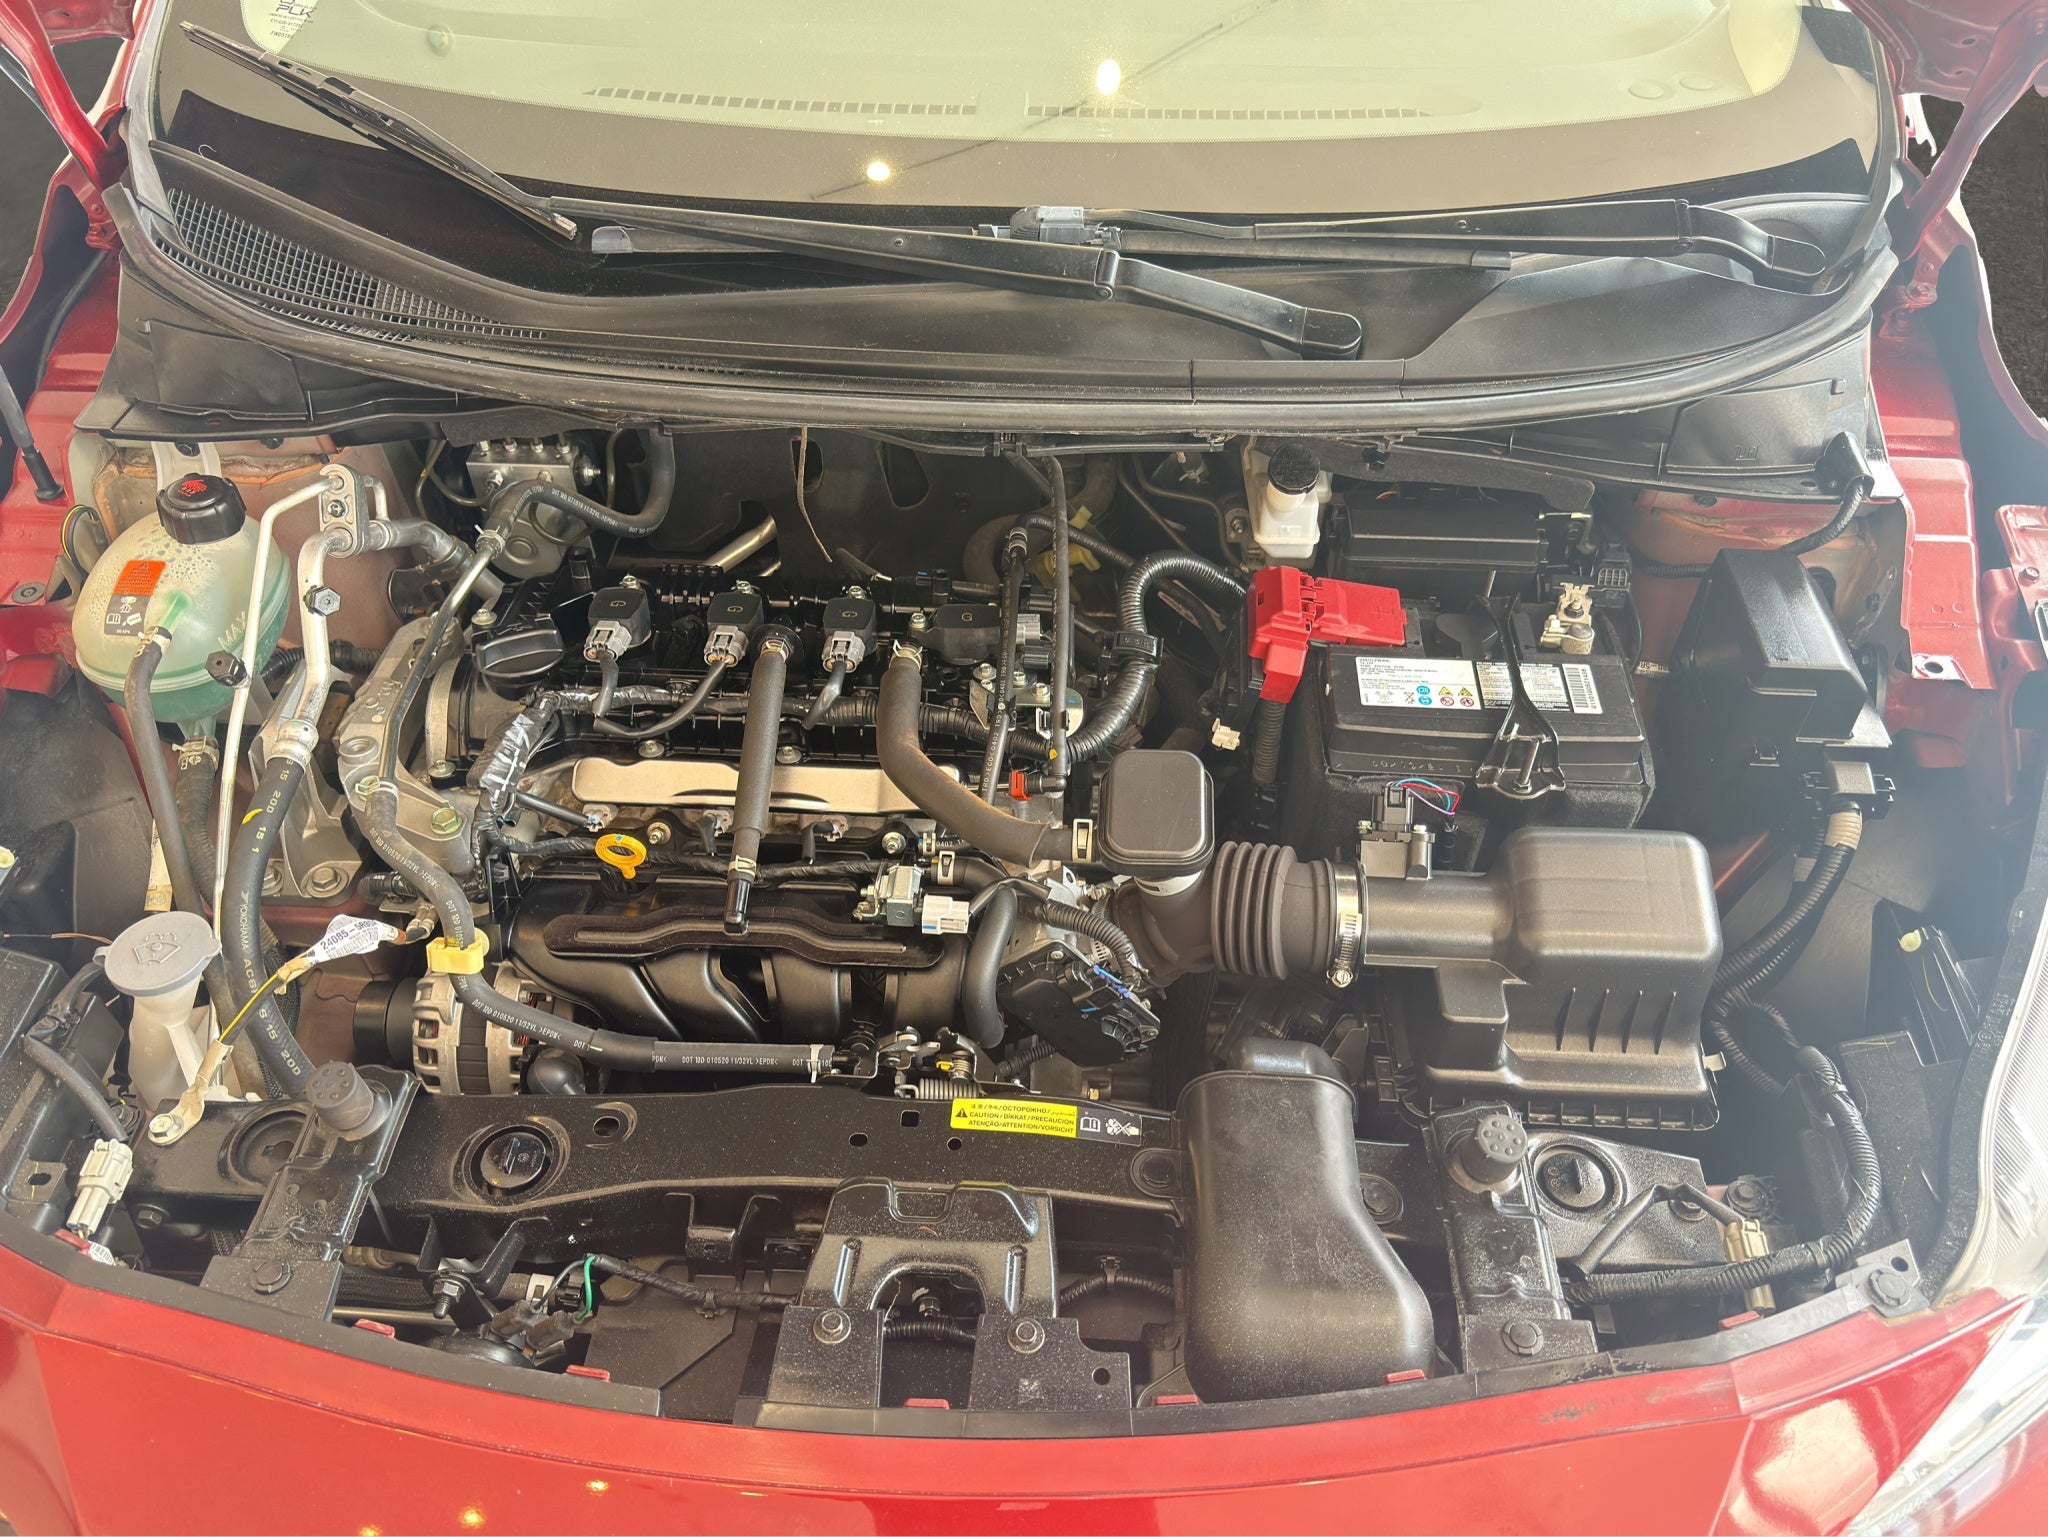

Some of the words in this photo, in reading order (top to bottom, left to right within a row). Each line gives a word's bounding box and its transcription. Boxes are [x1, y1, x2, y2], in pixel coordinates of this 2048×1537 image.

[280, 769, 290, 781] 15
[239, 902, 248, 951] YOKOHAMA
[266, 1023, 279, 1041] 15
[471, 998, 484, 1010] DOT
[573, 1039, 586, 1049] DOT
[681, 1056, 694, 1064] DOT
